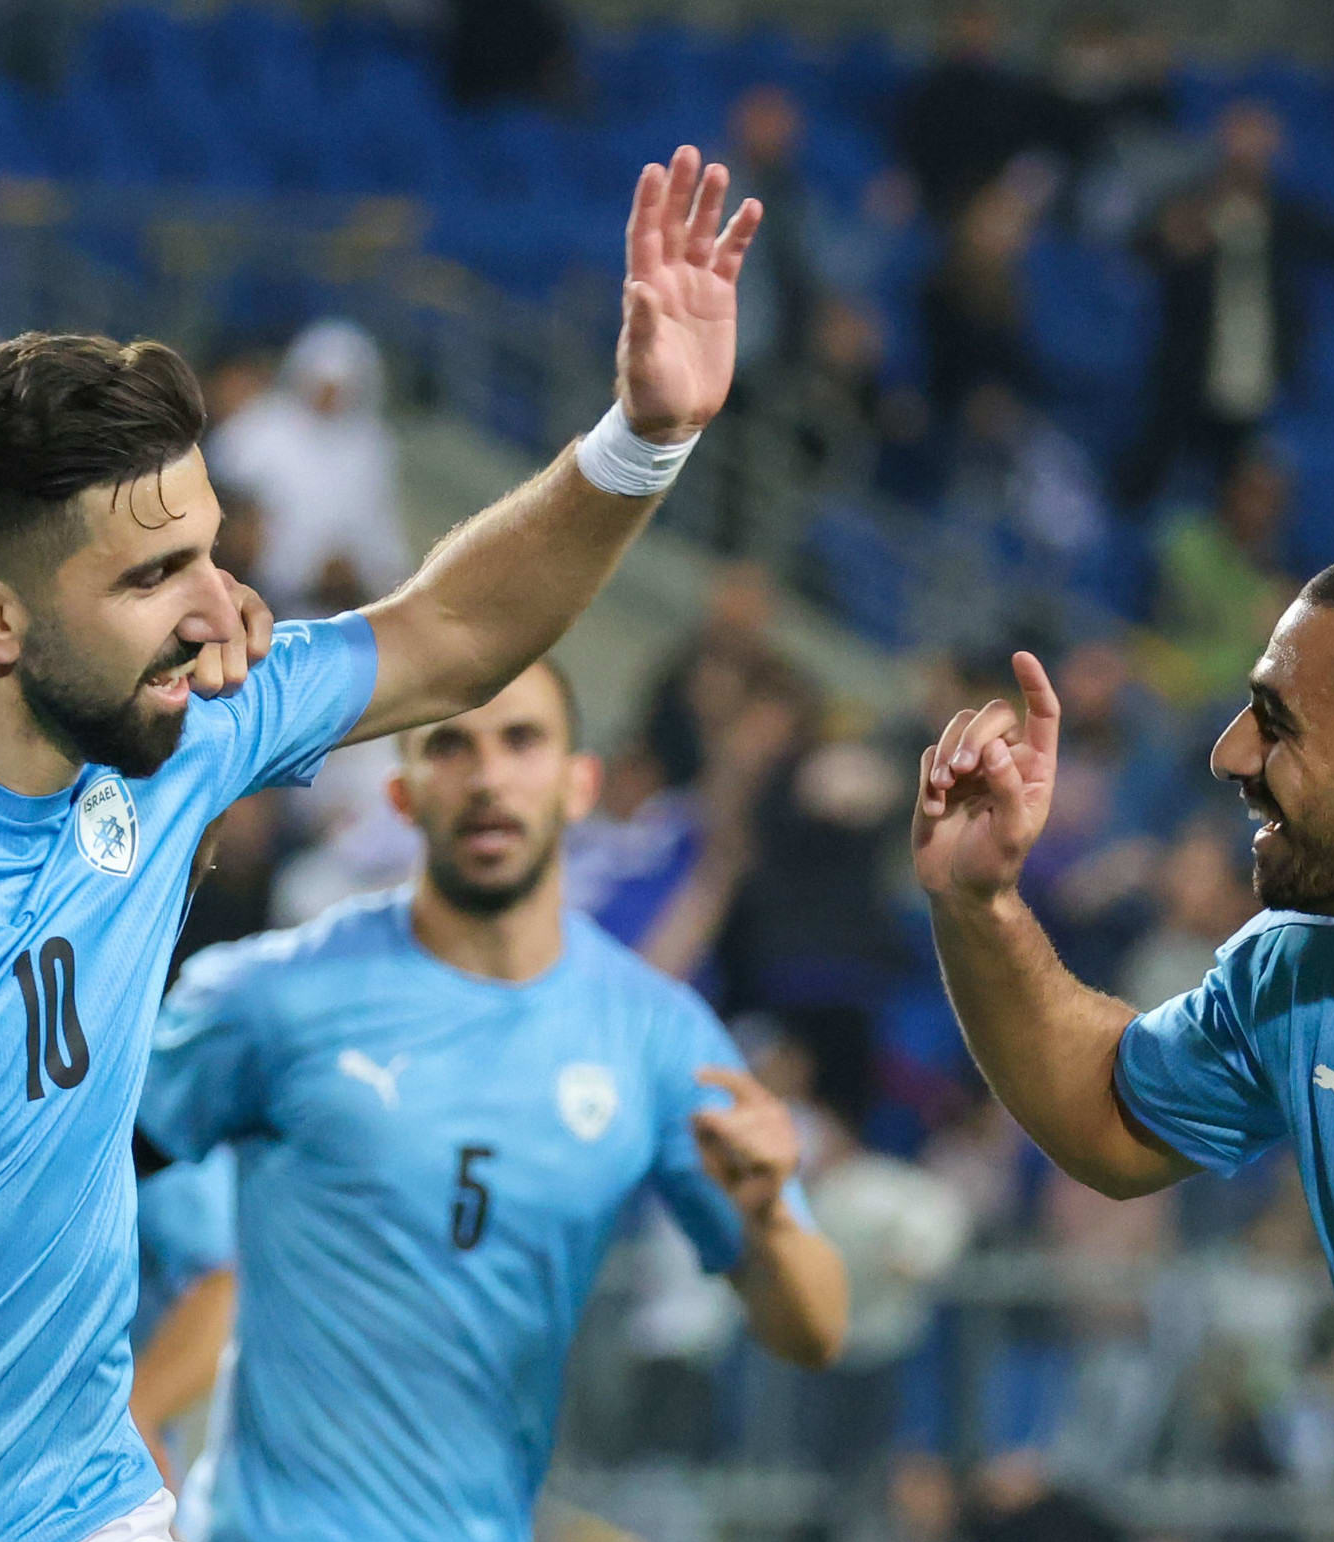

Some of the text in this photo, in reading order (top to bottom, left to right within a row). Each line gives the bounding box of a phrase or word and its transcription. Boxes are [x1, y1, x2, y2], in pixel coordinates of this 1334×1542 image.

[83, 785, 117, 814] ISRAEL
[12, 936, 90, 1102] 10
[449, 1145, 495, 1251] 5
